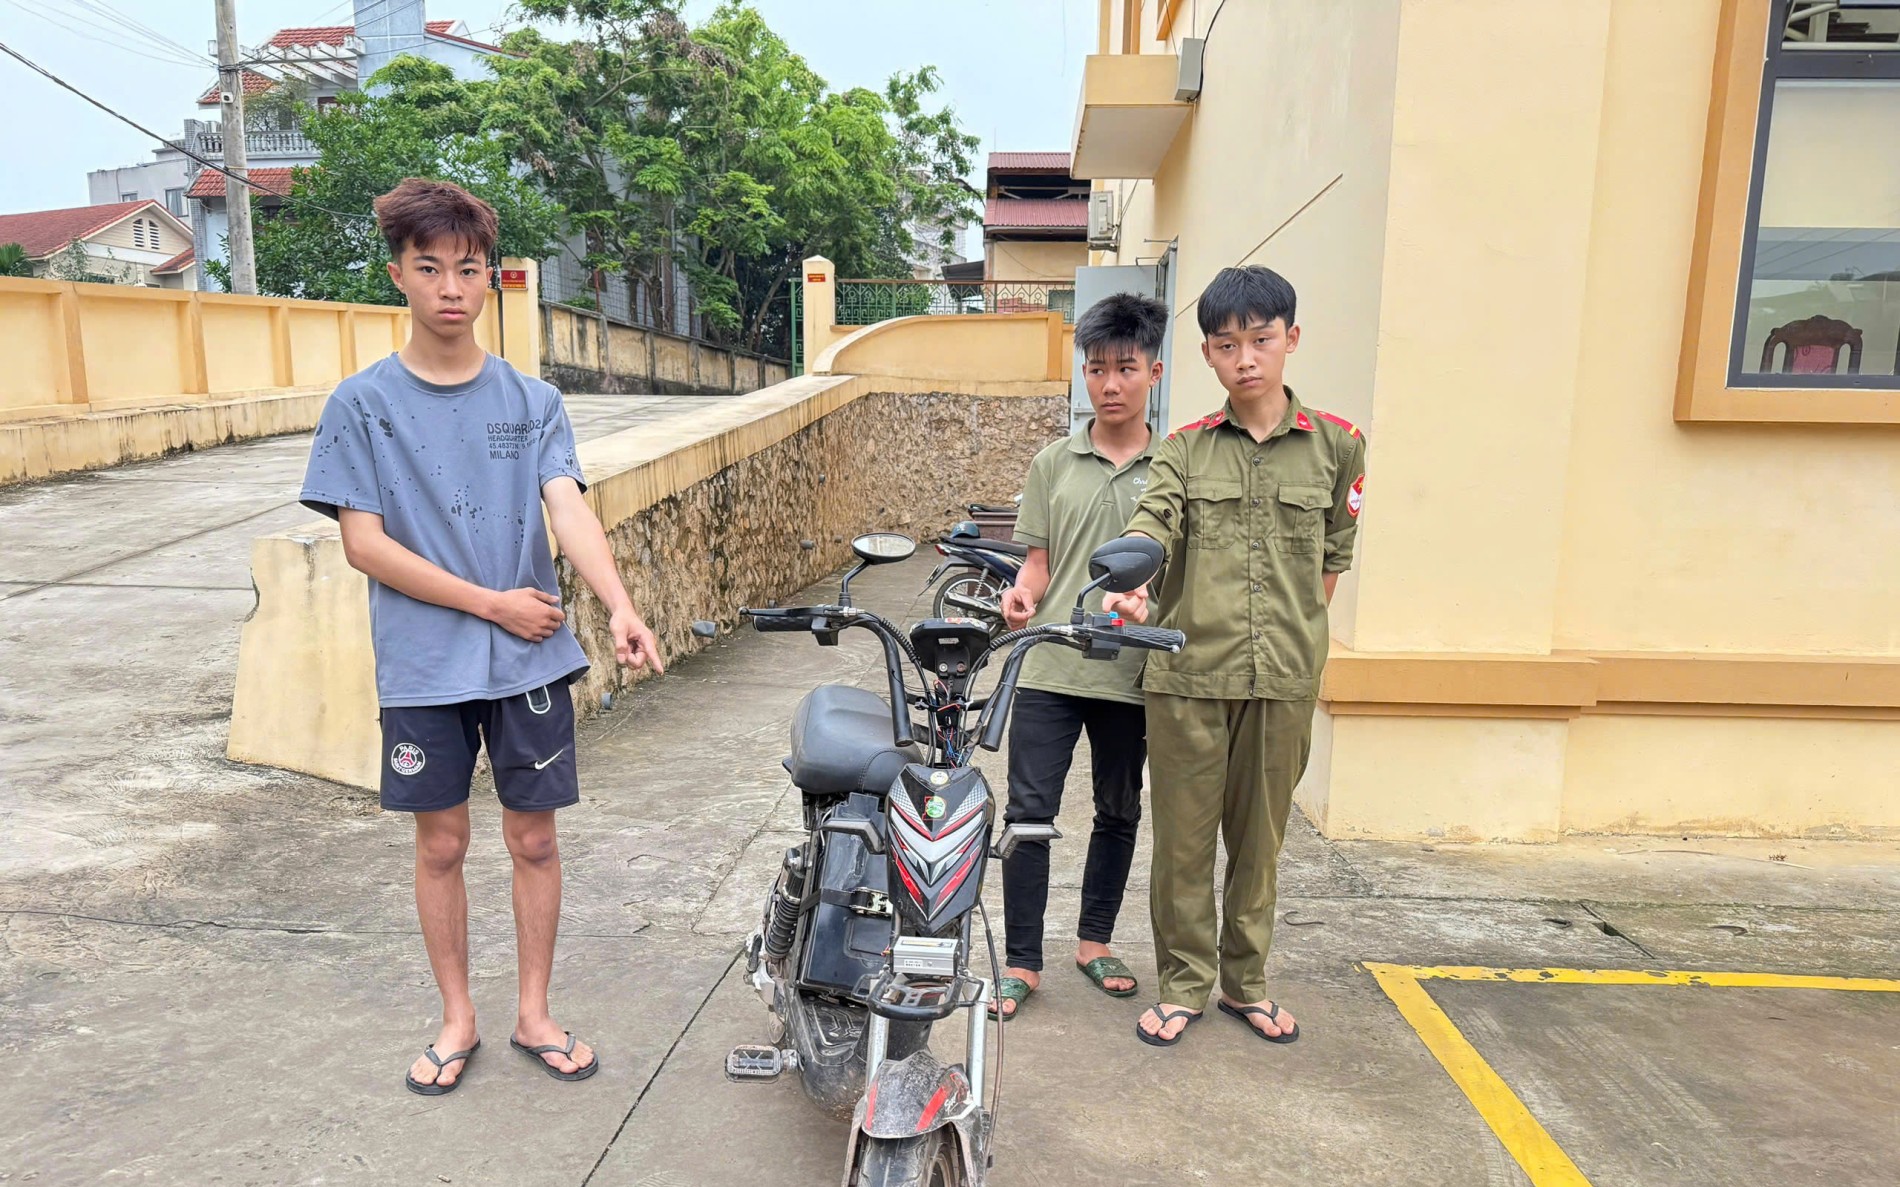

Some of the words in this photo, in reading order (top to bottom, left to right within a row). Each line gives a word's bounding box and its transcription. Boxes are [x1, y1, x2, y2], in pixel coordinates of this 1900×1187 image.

[487, 419, 541, 434] DSQUARD2
[490, 450, 520, 460] MILANO
[399, 745, 420, 755] PARIS
